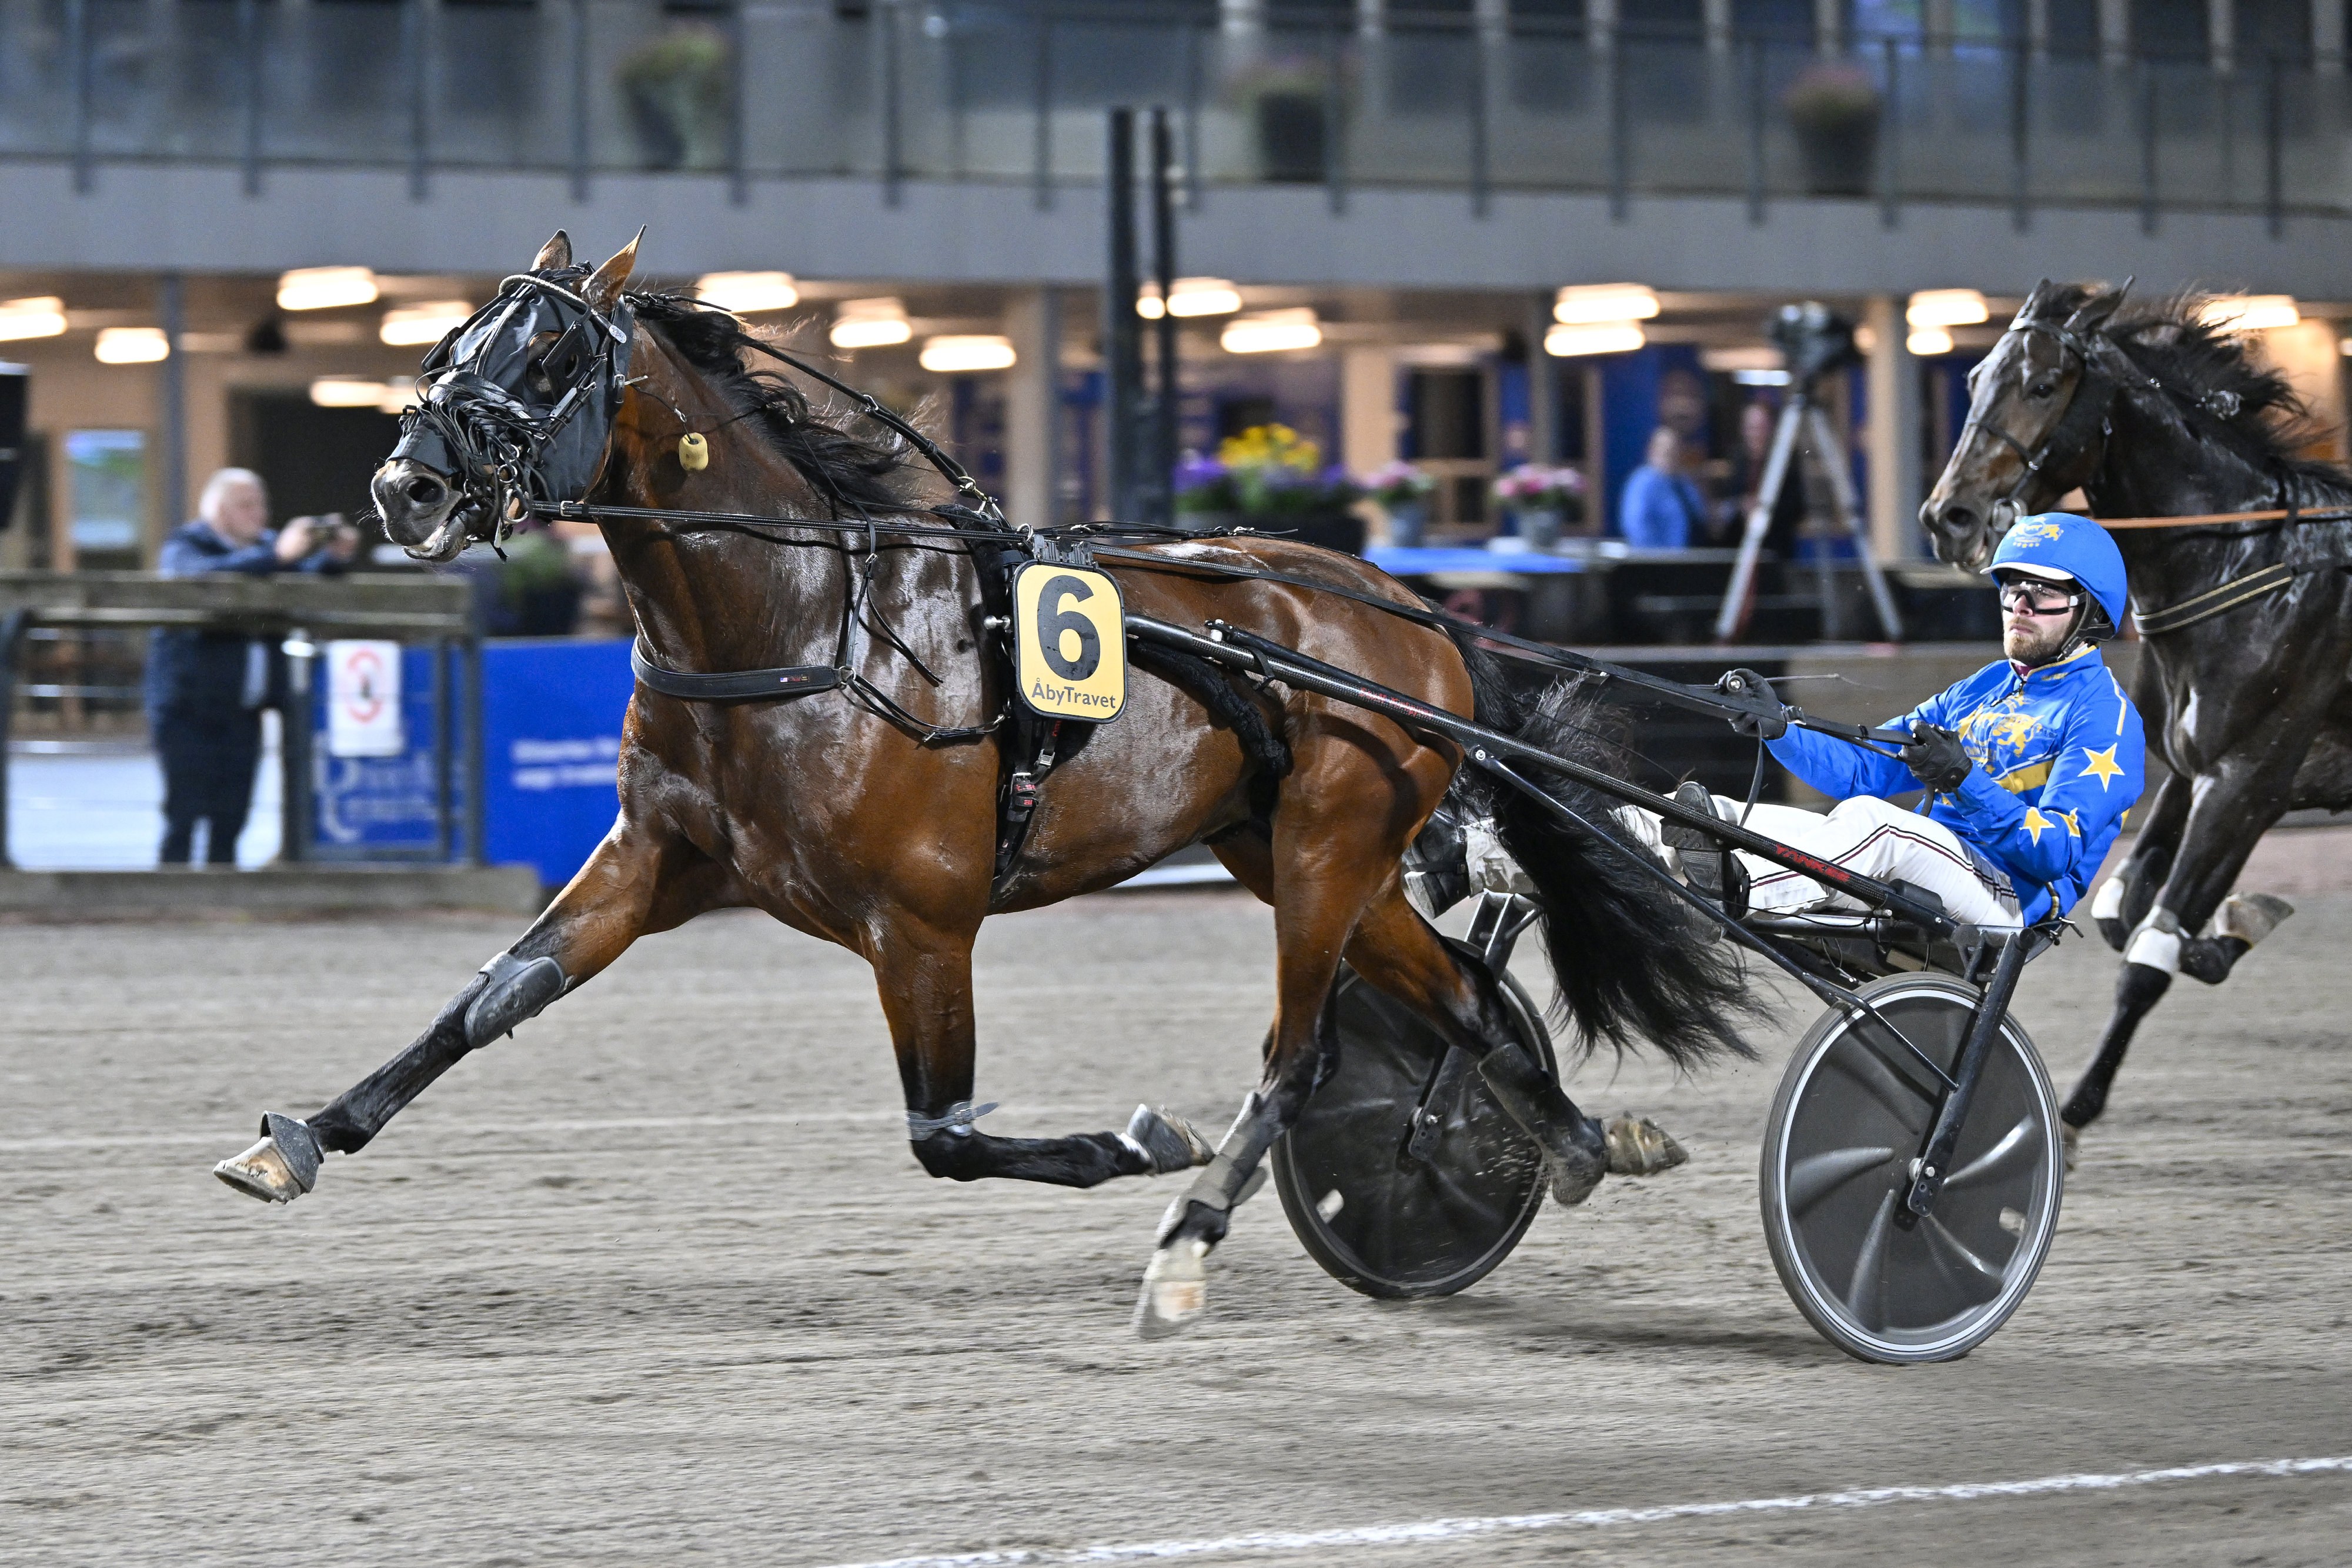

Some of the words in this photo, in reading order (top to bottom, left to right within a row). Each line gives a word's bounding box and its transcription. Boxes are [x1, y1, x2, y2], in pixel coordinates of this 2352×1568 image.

[1037, 575, 1101, 681] 6
[1031, 677, 1116, 709] ÅbyTravet
[1776, 842, 1851, 882] YANKEE
